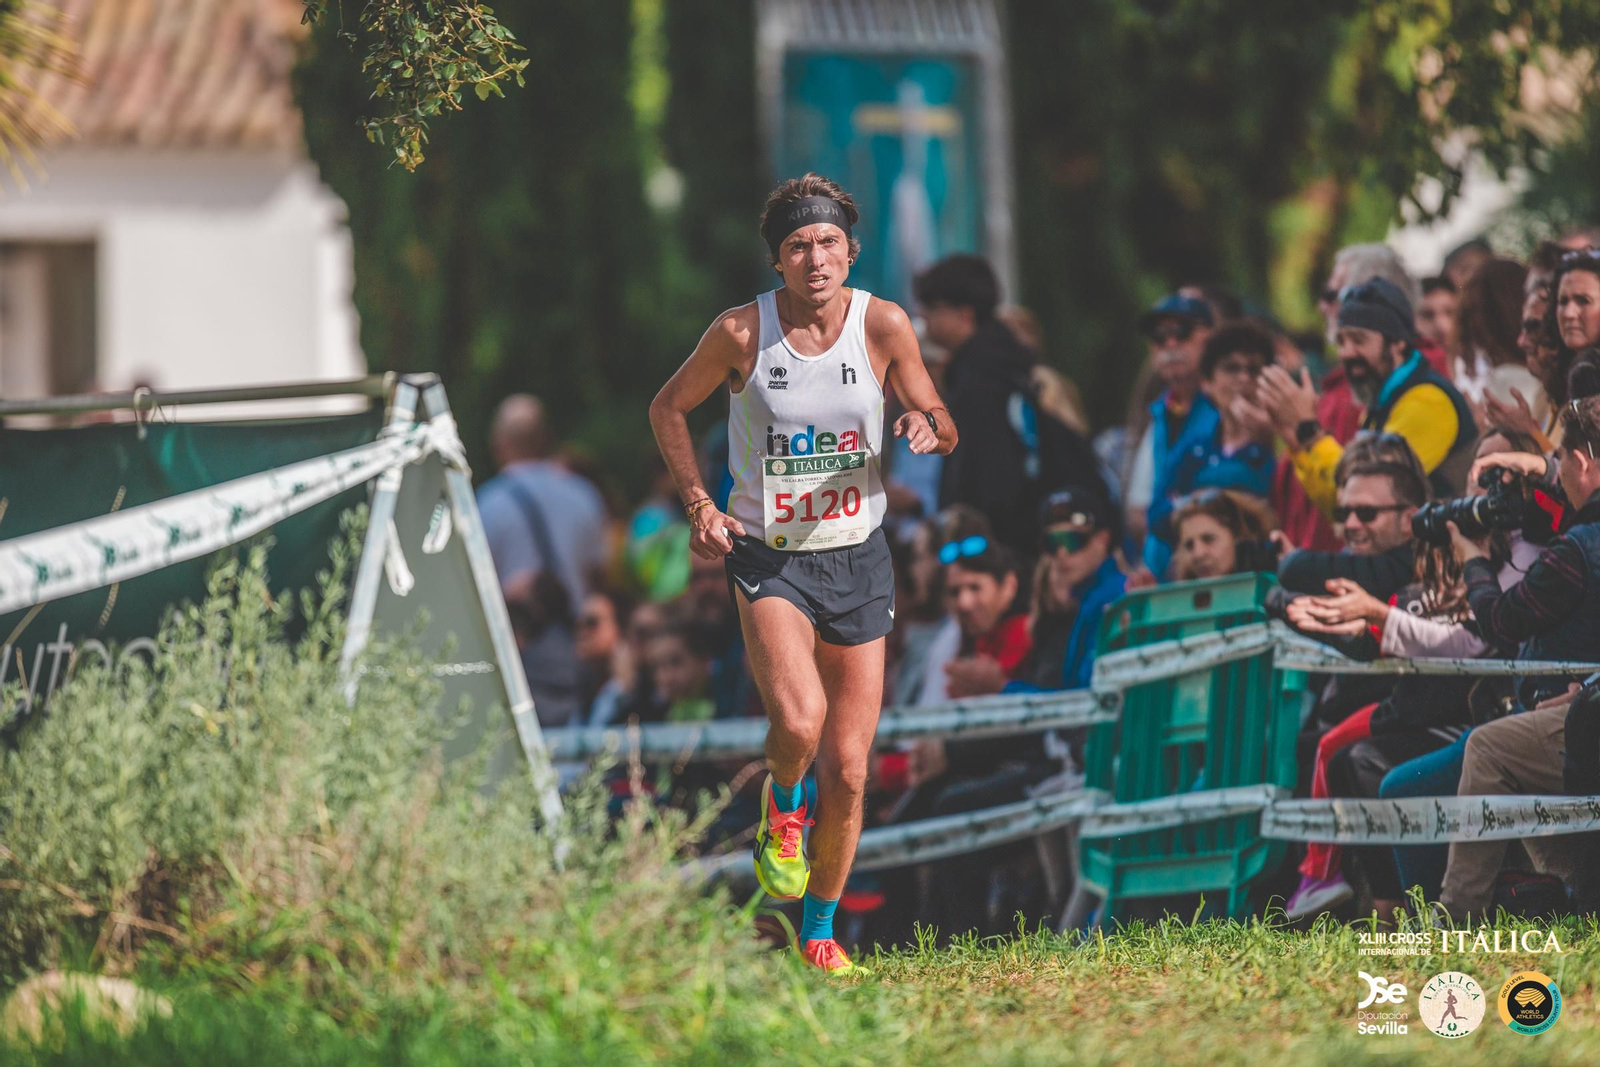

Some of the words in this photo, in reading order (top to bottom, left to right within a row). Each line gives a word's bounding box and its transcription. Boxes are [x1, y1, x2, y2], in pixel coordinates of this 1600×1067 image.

[788, 205, 839, 220] KIPRUN
[767, 425, 858, 456] indea
[793, 458, 842, 472] ITÁLICA
[775, 486, 861, 524] 5120
